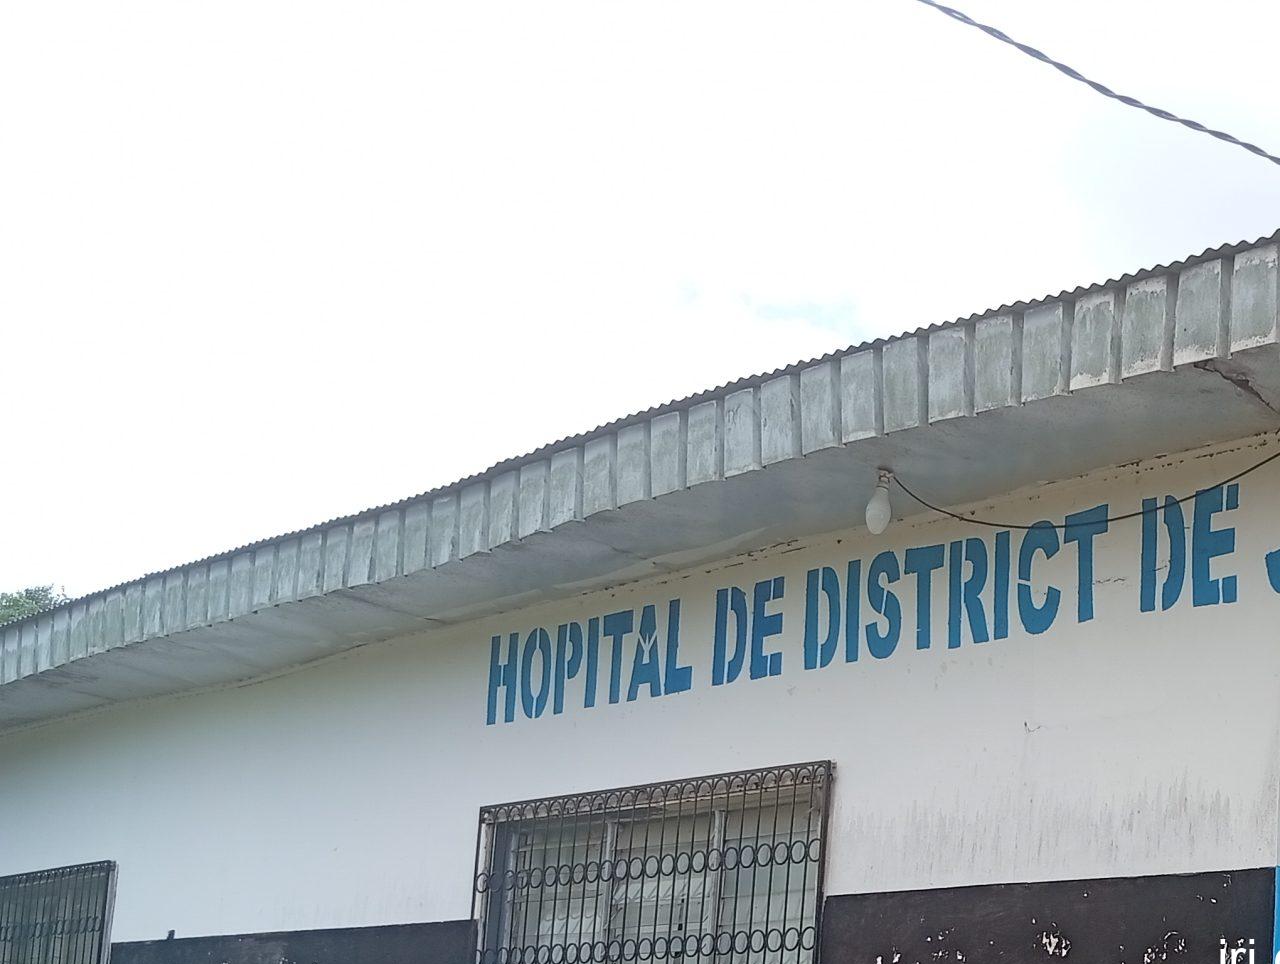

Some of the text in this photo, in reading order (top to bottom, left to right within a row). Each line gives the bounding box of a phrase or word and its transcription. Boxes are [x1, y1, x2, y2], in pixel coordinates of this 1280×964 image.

[486, 599, 693, 726] HOPITAL
[712, 576, 785, 687] DE
[803, 503, 1109, 671] DISTRICT
[1140, 483, 1239, 613] DE
